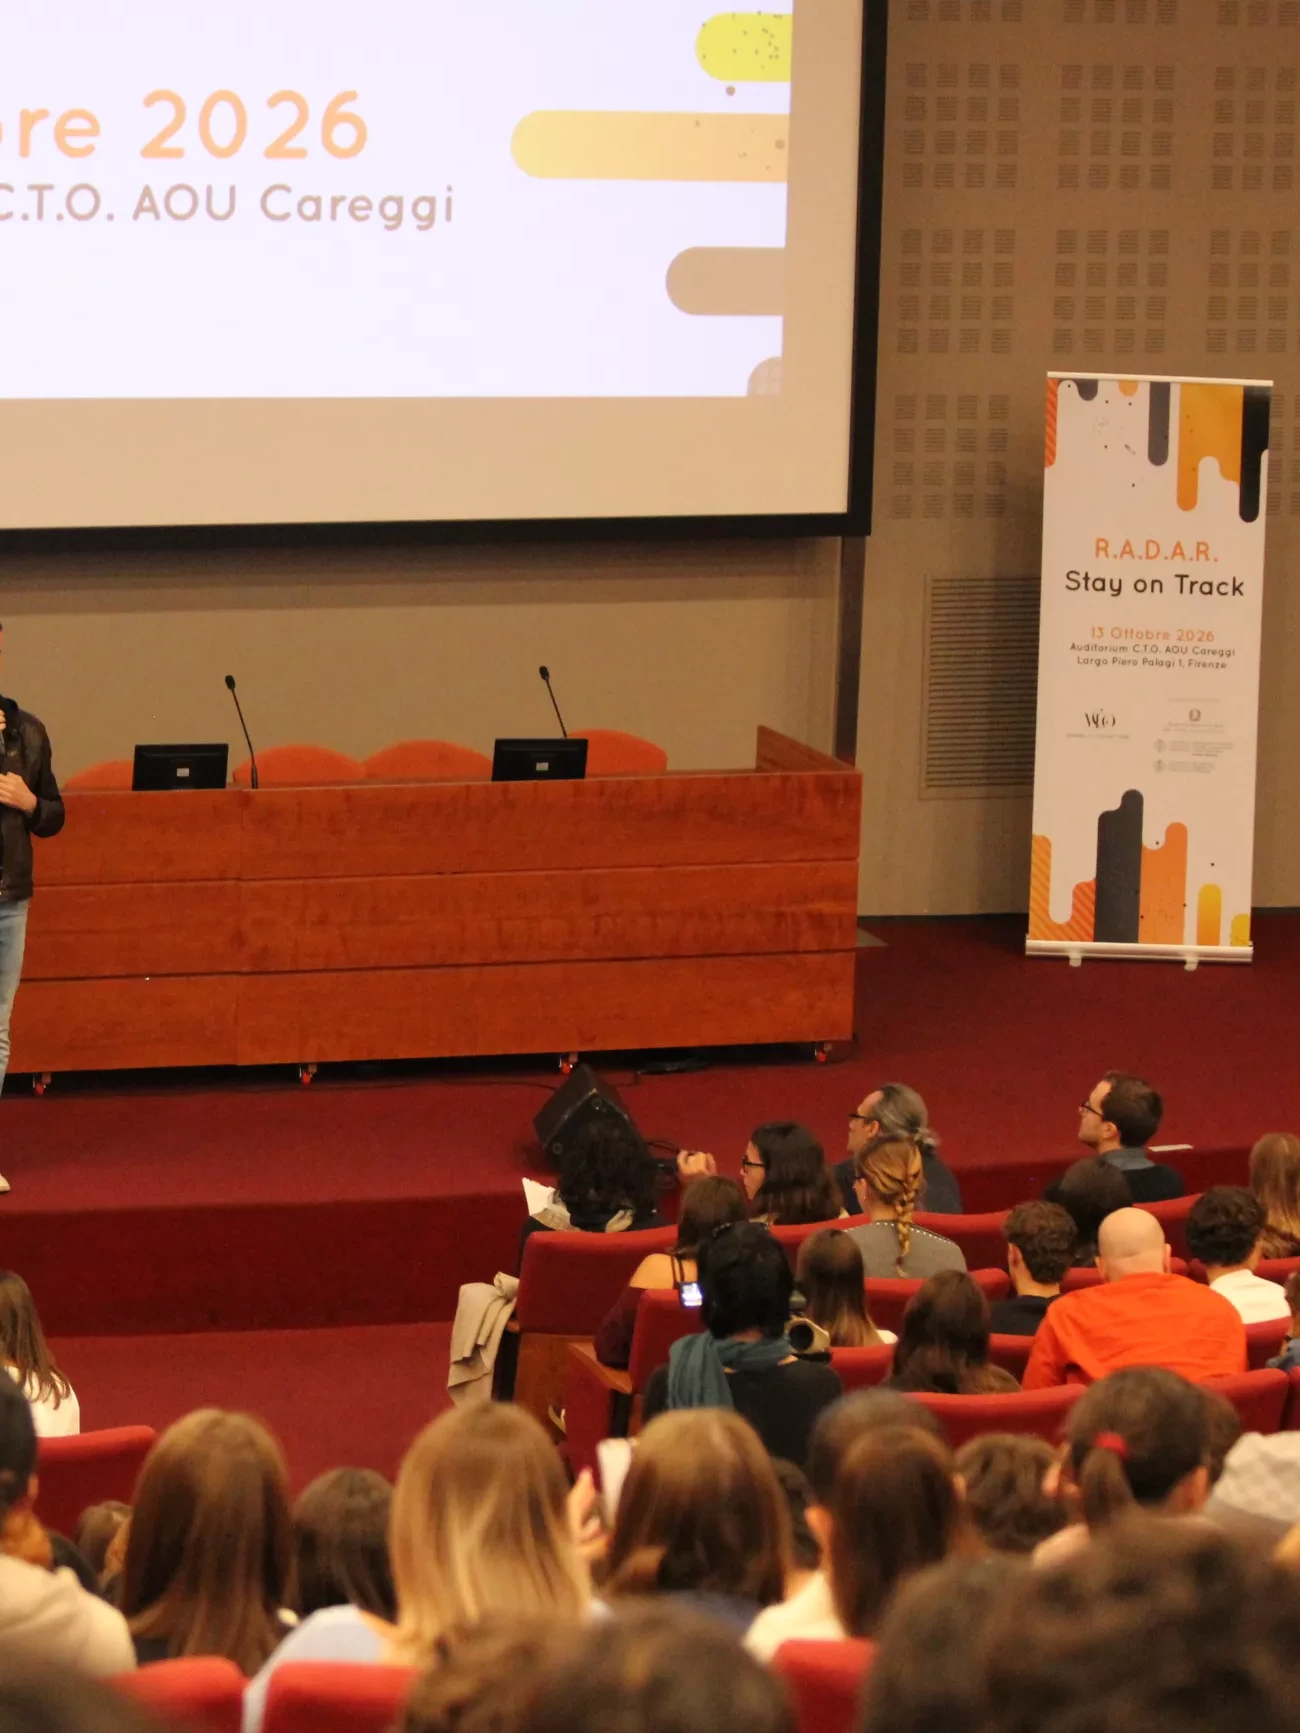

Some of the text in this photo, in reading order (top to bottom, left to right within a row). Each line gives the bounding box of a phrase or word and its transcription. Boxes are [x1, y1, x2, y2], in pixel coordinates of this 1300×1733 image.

[139, 89, 368, 160] 2026
[131, 183, 237, 222] AOU
[259, 183, 453, 232] Careggi
[1094, 537, 1219, 562] R.A.D.A.R.
[1065, 570, 1245, 597] Stay on Track
[1091, 626, 1215, 642] 13 Ottobre 2026
[1070, 642, 1236, 658] Auditorium C.T.O. AOU Careggi
[1077, 656, 1108, 667] Largo
[1112, 657, 1138, 666] Piero
[1188, 659, 1228, 669] Firenze
